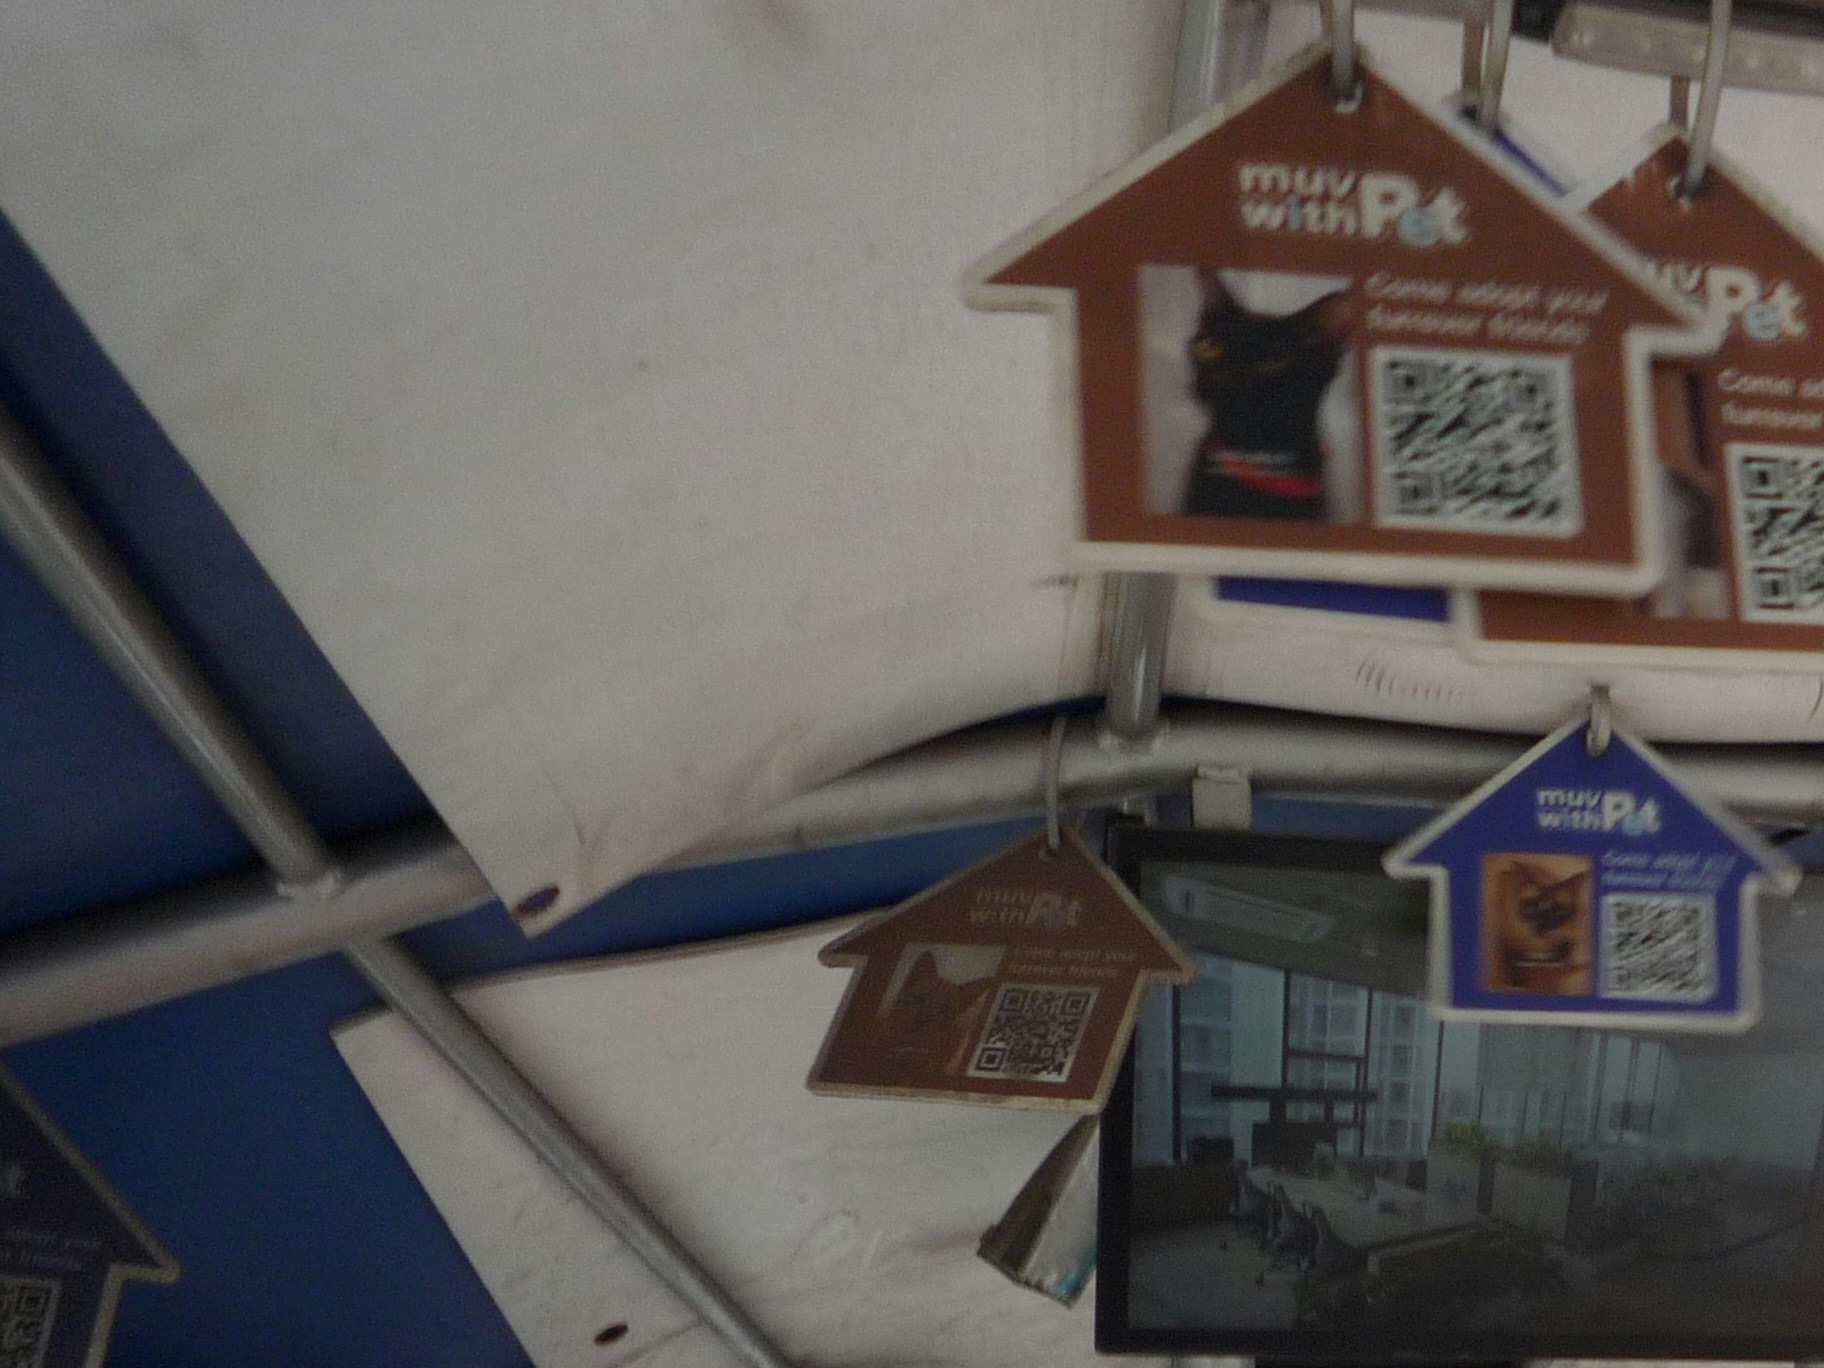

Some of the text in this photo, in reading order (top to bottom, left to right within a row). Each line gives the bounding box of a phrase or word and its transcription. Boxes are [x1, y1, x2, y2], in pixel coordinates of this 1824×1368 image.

[1239, 162, 1356, 196] muv
[1241, 172, 1468, 248] with Pet
[1537, 789, 1601, 808] muv
[1538, 791, 1662, 836] with Pet
